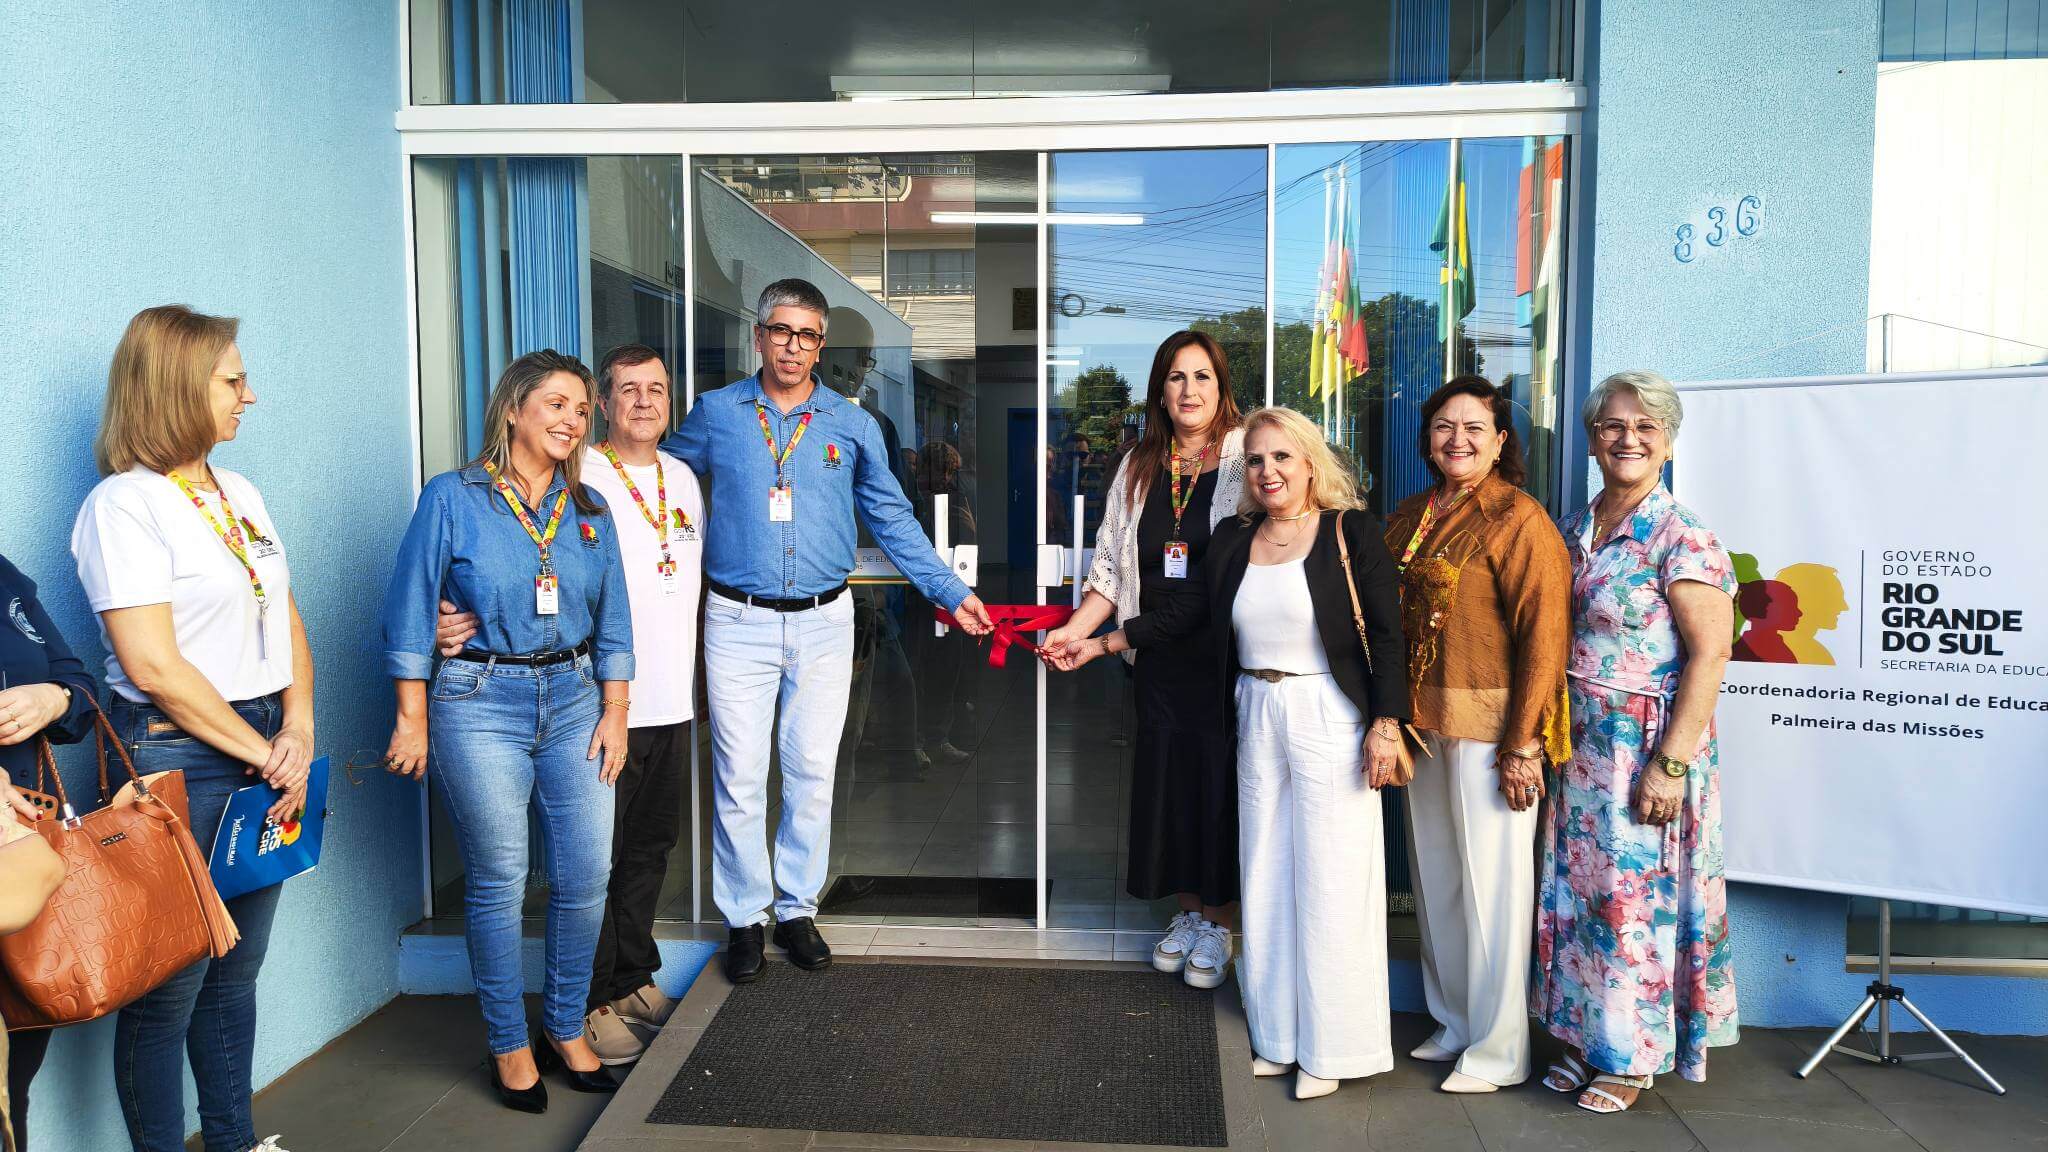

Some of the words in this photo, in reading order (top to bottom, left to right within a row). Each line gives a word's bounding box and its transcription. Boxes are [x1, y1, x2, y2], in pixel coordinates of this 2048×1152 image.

[1674, 195, 1761, 263] 836
[1883, 550, 1975, 562] GOVERNO
[1883, 564, 1909, 576] DO
[1917, 565, 1992, 577] ESTADO
[1882, 582, 1939, 605] RIO
[1881, 606, 2023, 632] GRANDE
[1882, 630, 1931, 653] DO
[1938, 632, 2004, 656] SUL
[1880, 659, 1971, 673] SECRETARIA
[1976, 663, 1997, 675] DA
[1862, 689, 1949, 707] Regional
[1955, 694, 1981, 708] de
[1771, 713, 1857, 731] Palmeira
[1862, 719, 1897, 733] das
[1903, 721, 1984, 739] Missões
